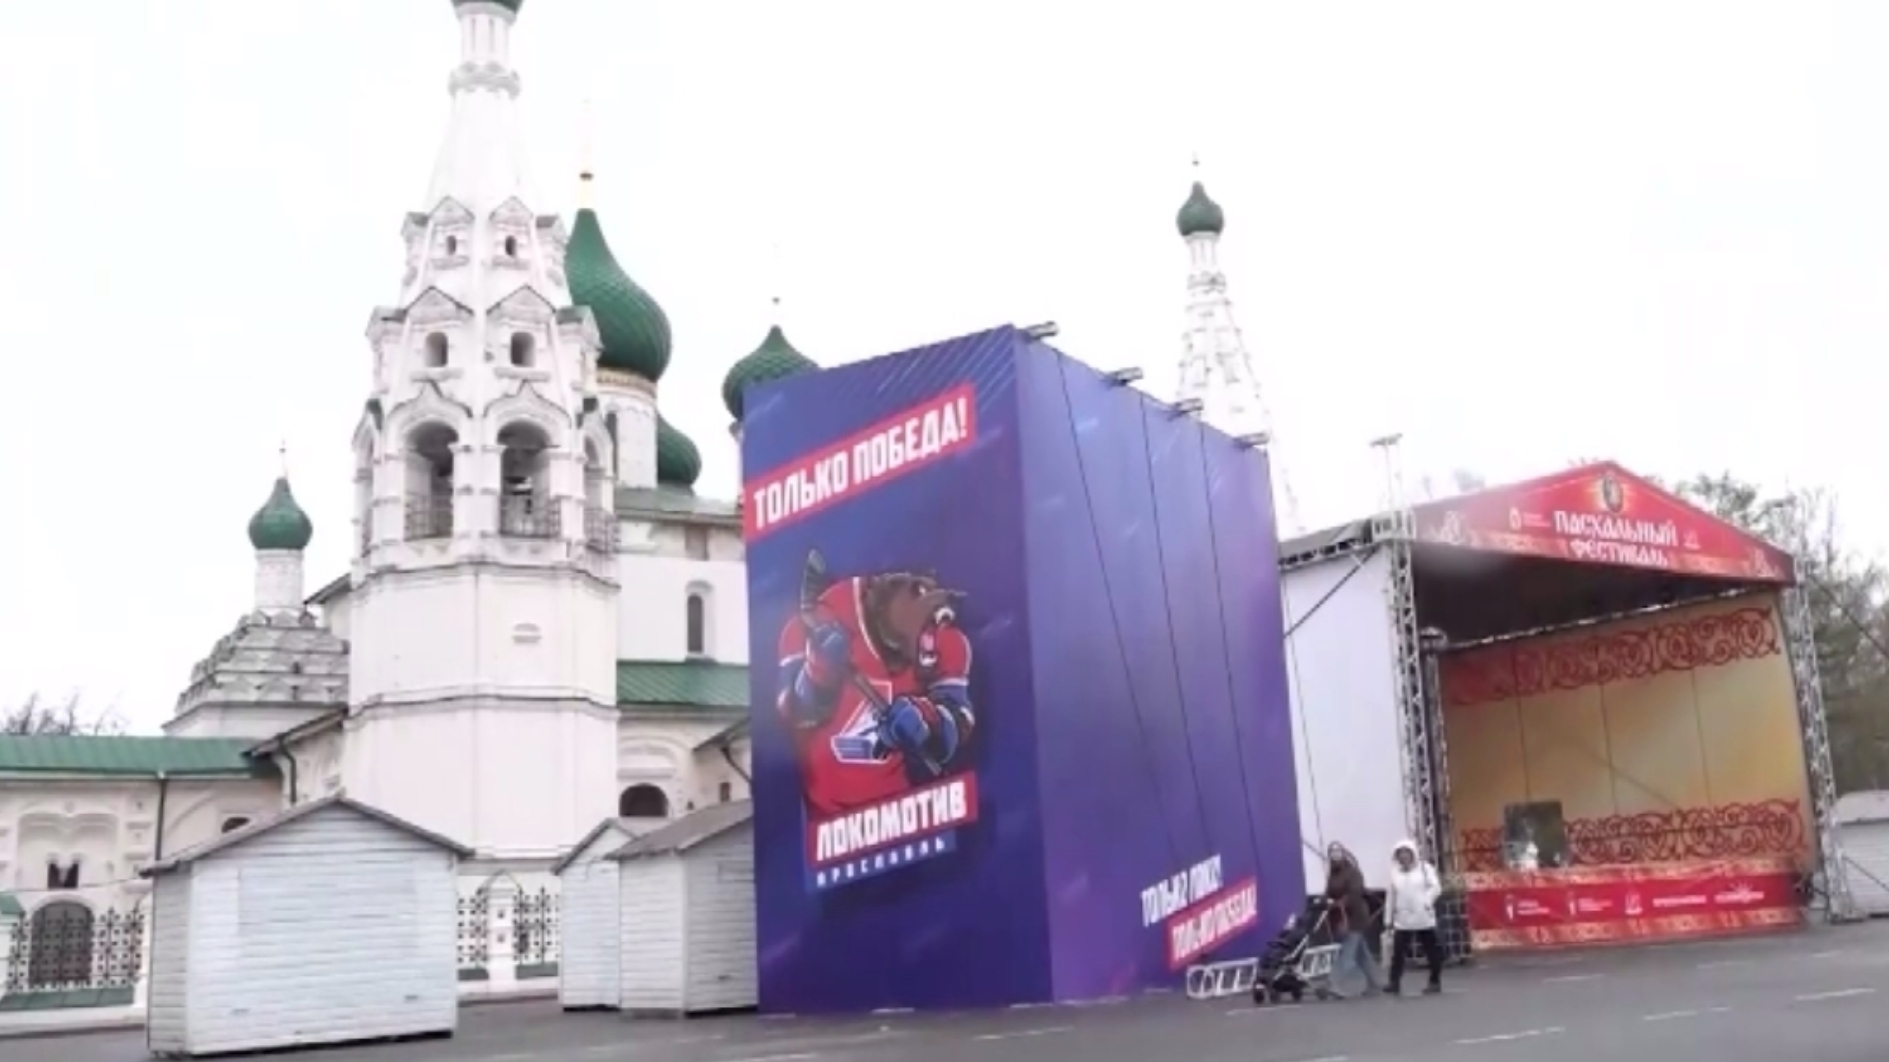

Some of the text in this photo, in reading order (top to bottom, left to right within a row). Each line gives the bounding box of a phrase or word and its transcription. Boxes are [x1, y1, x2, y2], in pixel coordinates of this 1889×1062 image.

[754, 397, 968, 530] ТОЛЬКО ПОБЕДА!
[816, 780, 967, 862] ЛОКОМОТИВ
